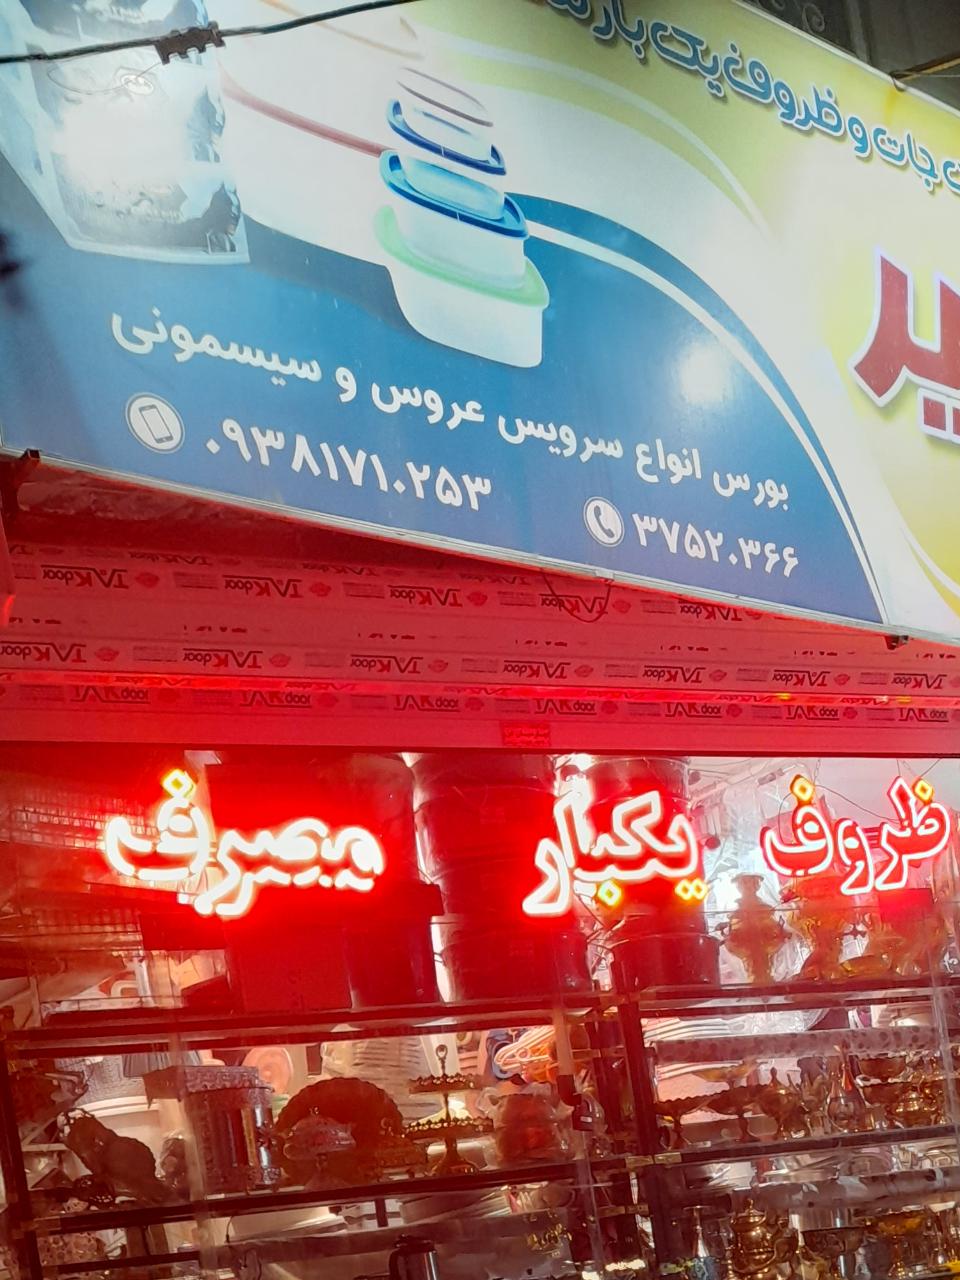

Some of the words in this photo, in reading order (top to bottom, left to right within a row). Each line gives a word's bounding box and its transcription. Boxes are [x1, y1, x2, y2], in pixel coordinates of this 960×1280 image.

[722, 41, 846, 136] ظروف
[848, 115, 872, 158] و
[873, 128, 941, 191] جات
[111, 307, 323, 387] سیسمونی
[334, 366, 358, 403] و
[370, 382, 485, 430] عروس
[498, 413, 624, 462] سرویس
[634, 440, 702, 486] انواع
[713, 464, 789, 511] بورس
[104, 769, 384, 918] مصرف
[760, 773, 951, 896] ظروف
